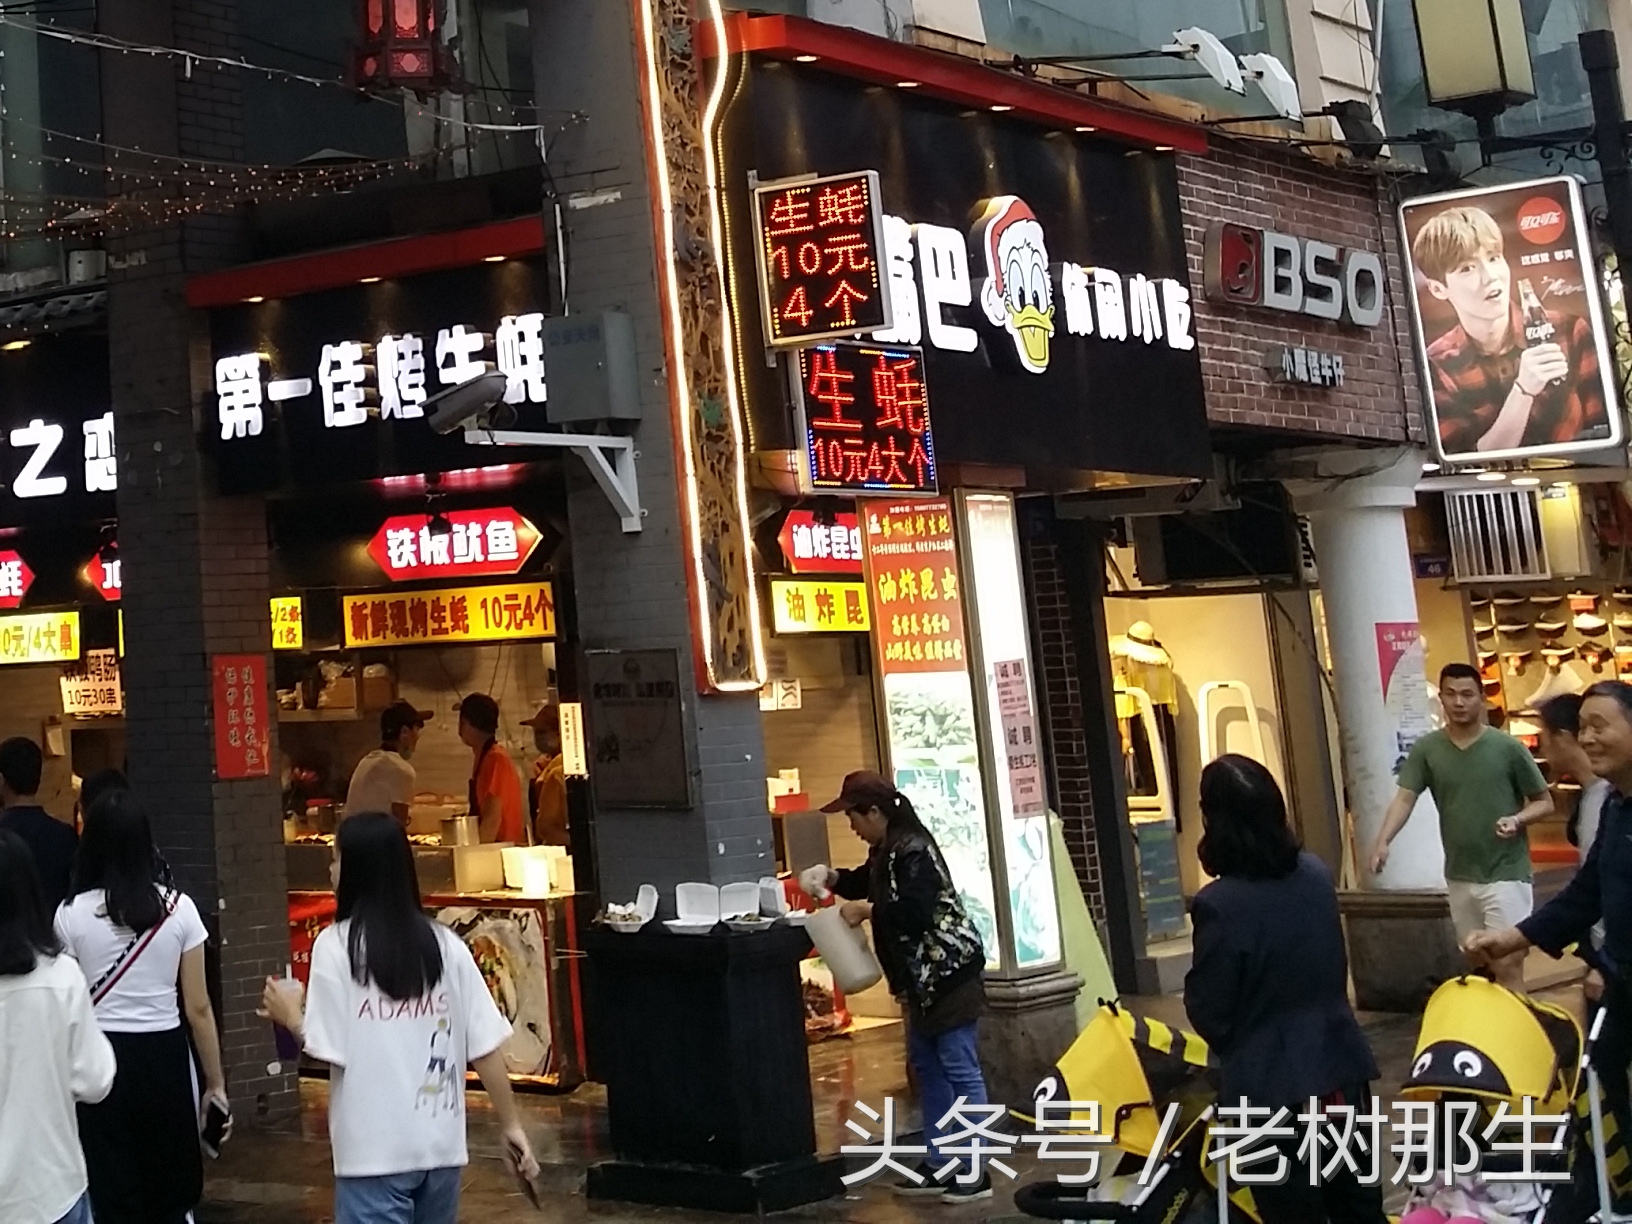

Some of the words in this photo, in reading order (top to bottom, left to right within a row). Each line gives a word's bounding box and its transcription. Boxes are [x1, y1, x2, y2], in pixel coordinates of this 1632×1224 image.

[769, 183, 866, 236] 生蚝
[1520, 211, 1561, 230] 可口可乐
[770, 232, 869, 280] 10元
[1263, 230, 1384, 327] BSO
[782, 279, 869, 328] 4个
[1063, 261, 1195, 352] 休闲小吃
[215, 312, 547, 441] 第一佳烤生蚝
[809, 349, 925, 434] 生蚝
[812, 435, 932, 487] 10元4大个
[386, 520, 519, 569] 铁板鱿鱼
[786, 587, 865, 627] 油炸昆
[878, 567, 958, 605] 油炸昆虫
[351, 596, 469, 641] 新鲜现烤生蚝
[480, 589, 554, 631] 10元4个
[68, 688, 117, 707] 10元30串
[358, 993, 451, 1021] ADAMS
